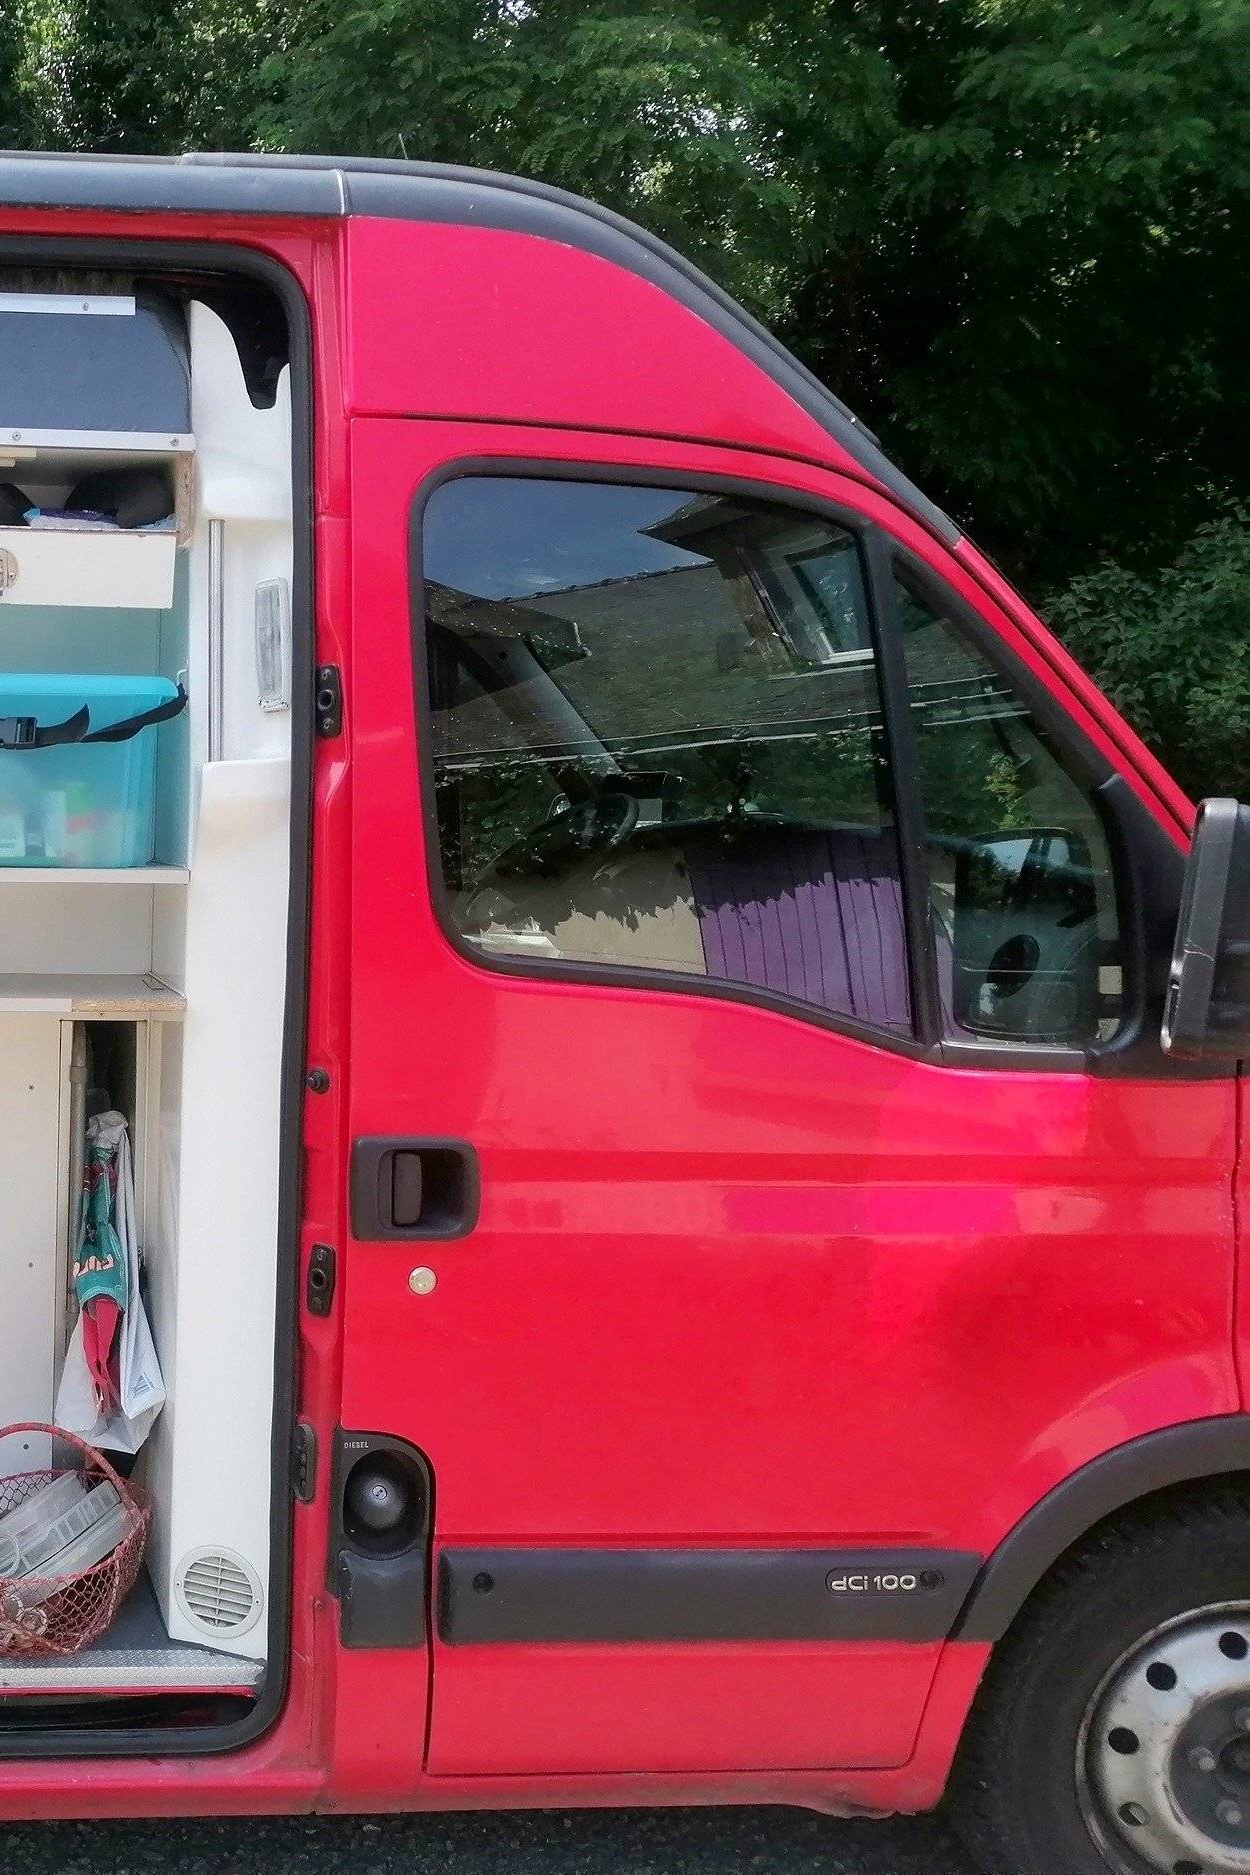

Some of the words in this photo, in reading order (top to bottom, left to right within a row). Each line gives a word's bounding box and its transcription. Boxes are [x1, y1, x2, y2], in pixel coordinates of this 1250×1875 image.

[343, 1441, 369, 1449] DIESEL
[831, 1575, 869, 1591] dCi
[873, 1574, 917, 1591] 100
